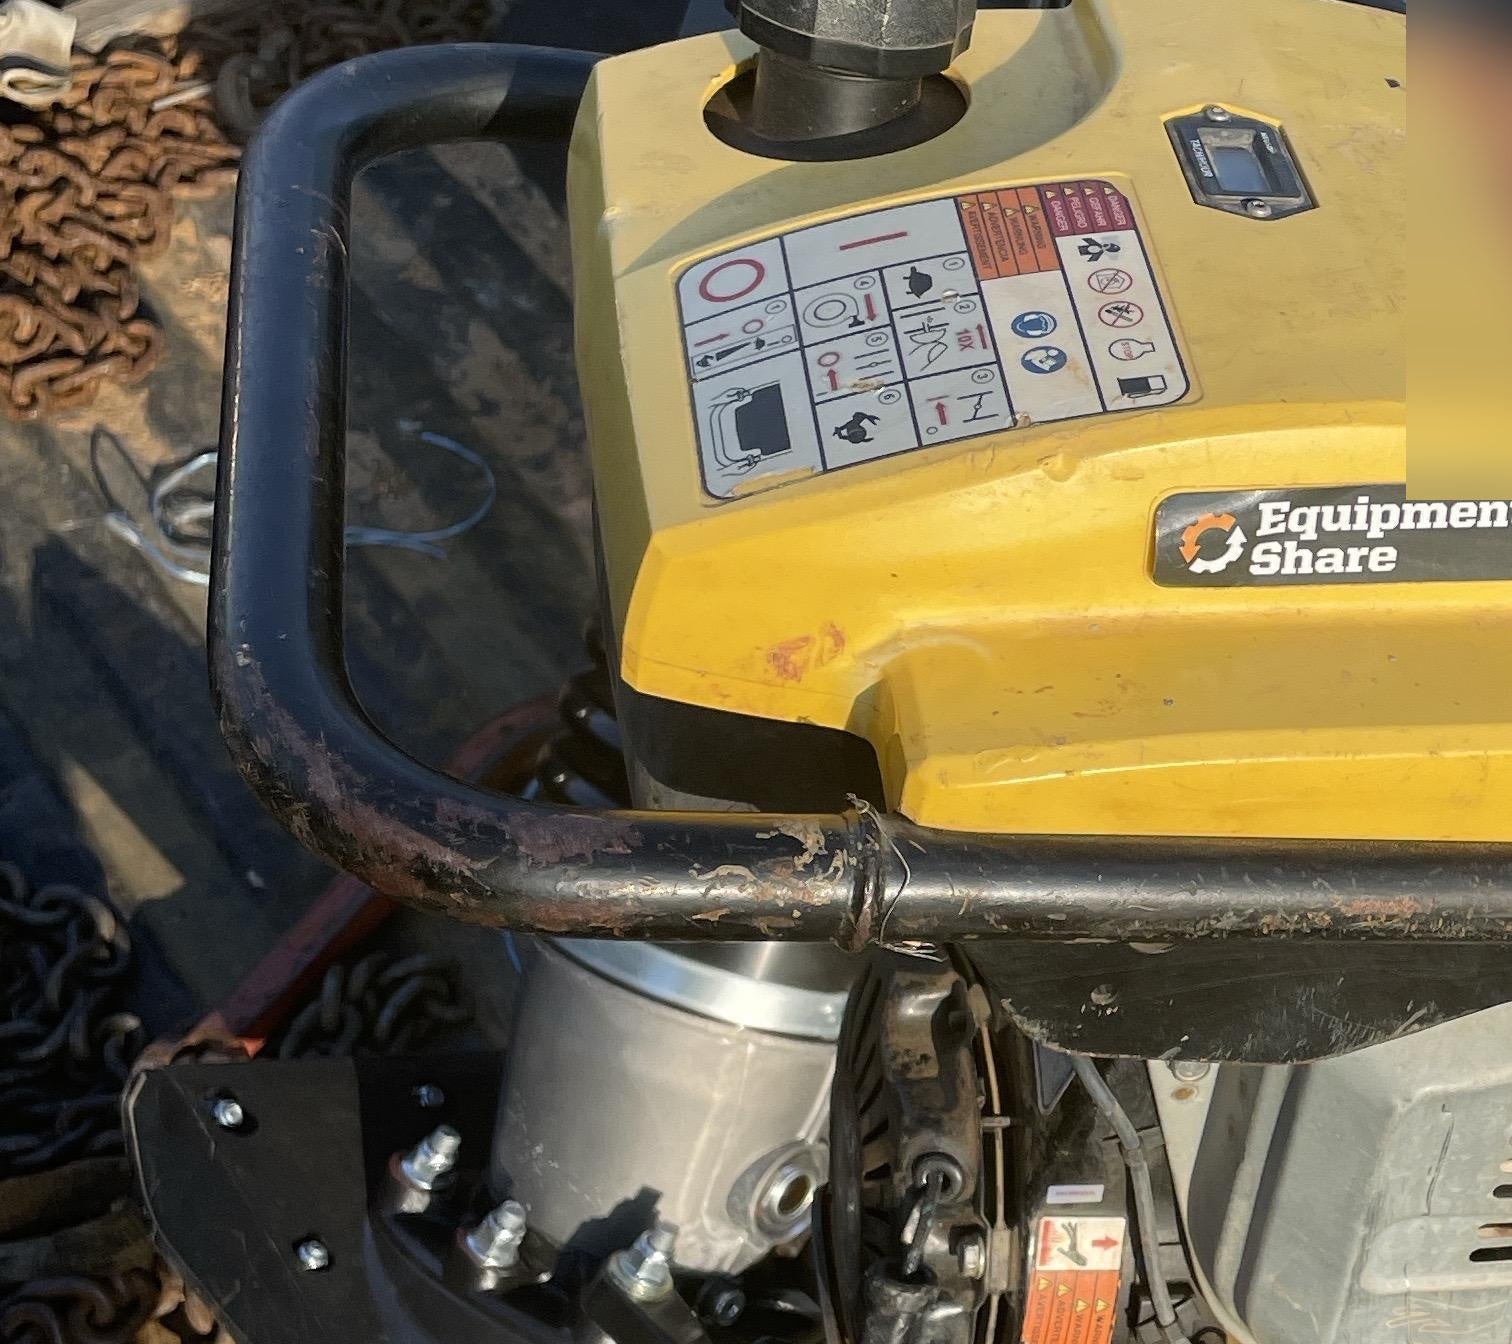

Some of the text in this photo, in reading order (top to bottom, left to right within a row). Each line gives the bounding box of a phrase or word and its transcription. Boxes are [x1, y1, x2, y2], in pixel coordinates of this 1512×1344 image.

[1050, 200, 1069, 232] DANGER
[1069, 196, 1088, 230] PELIGRO
[1088, 197, 1107, 227] GEFAHR
[1107, 195, 1127, 226] DANGER
[956, 327, 975, 352] 10X
[1248, 540, 1398, 576] Share
